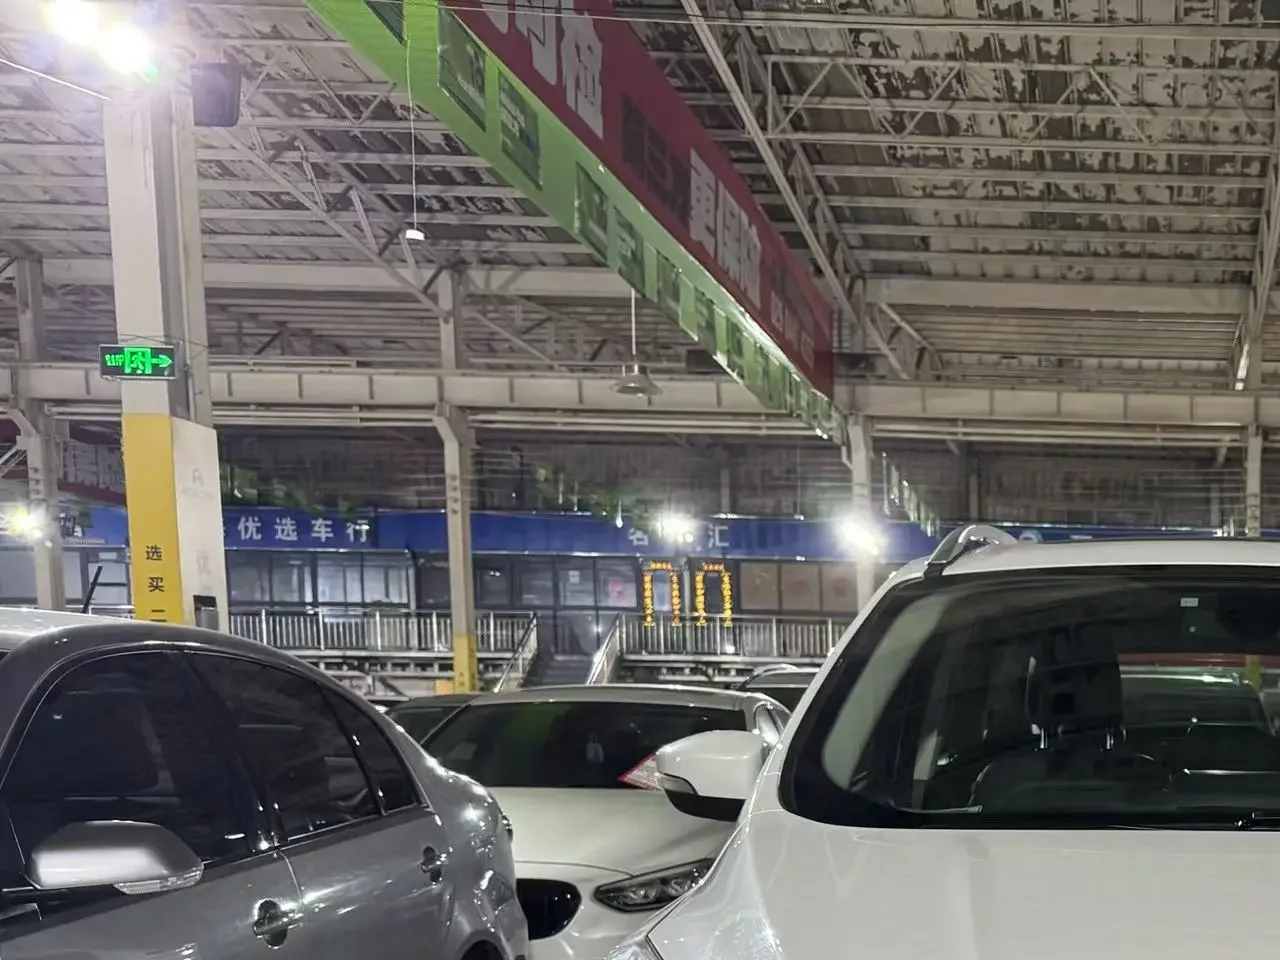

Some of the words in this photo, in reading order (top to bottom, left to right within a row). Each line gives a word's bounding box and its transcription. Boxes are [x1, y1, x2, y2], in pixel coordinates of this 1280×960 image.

[223, 516, 370, 543] 优选车行
[627, 525, 730, 548] 名汇
